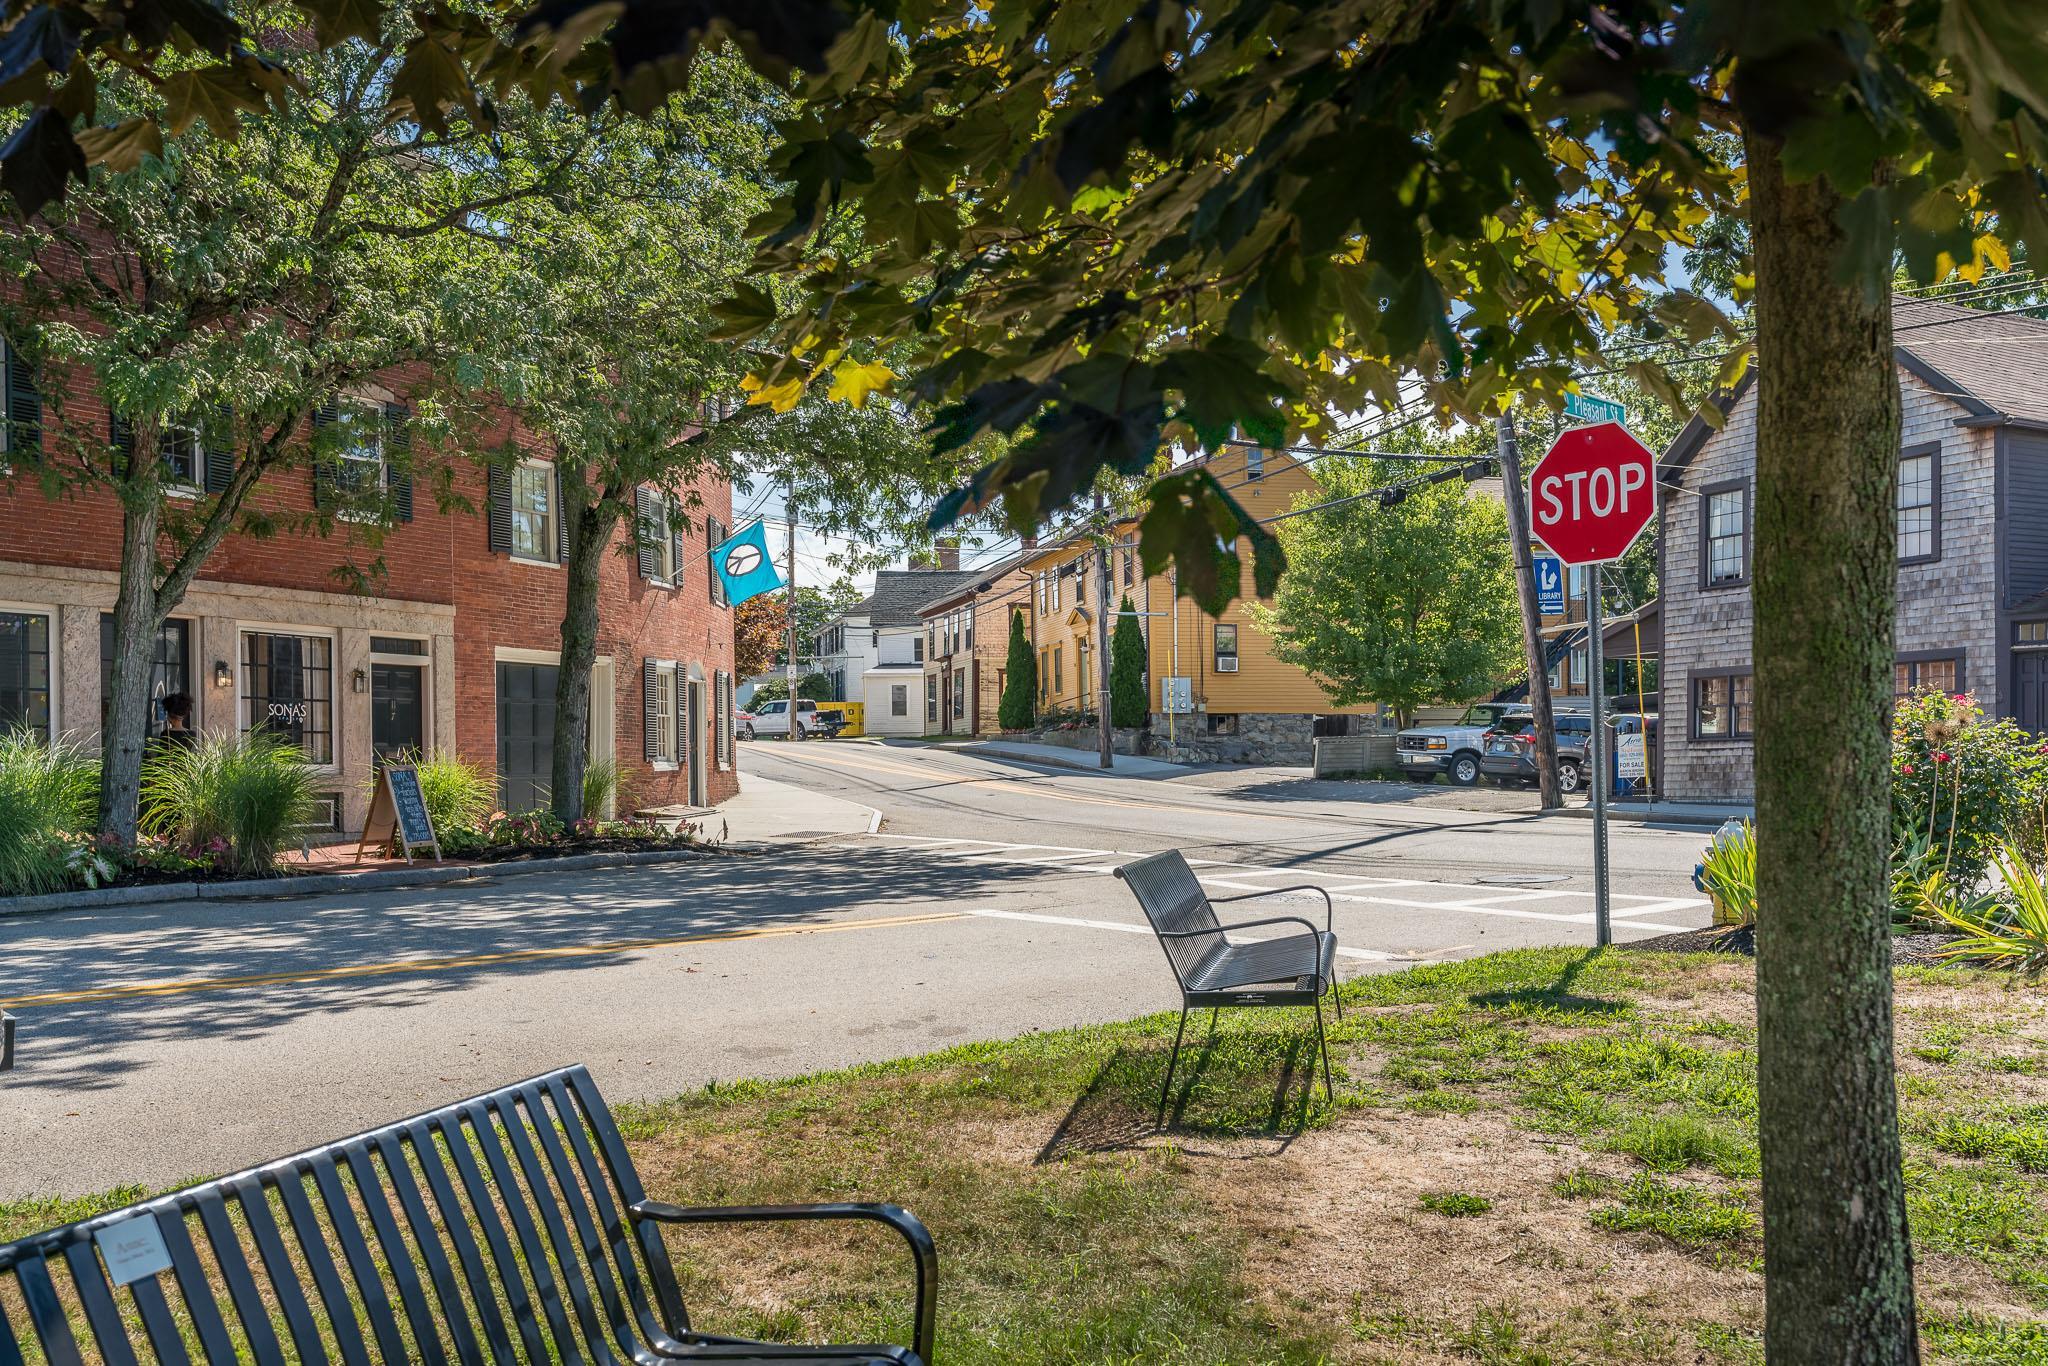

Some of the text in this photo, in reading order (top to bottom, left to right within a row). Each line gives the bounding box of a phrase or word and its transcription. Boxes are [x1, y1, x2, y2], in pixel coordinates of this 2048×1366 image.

[1574, 395, 1607, 422] Pleasant
[1538, 462, 1646, 525] STOP
[1538, 591, 1561, 600] LIBRARY
